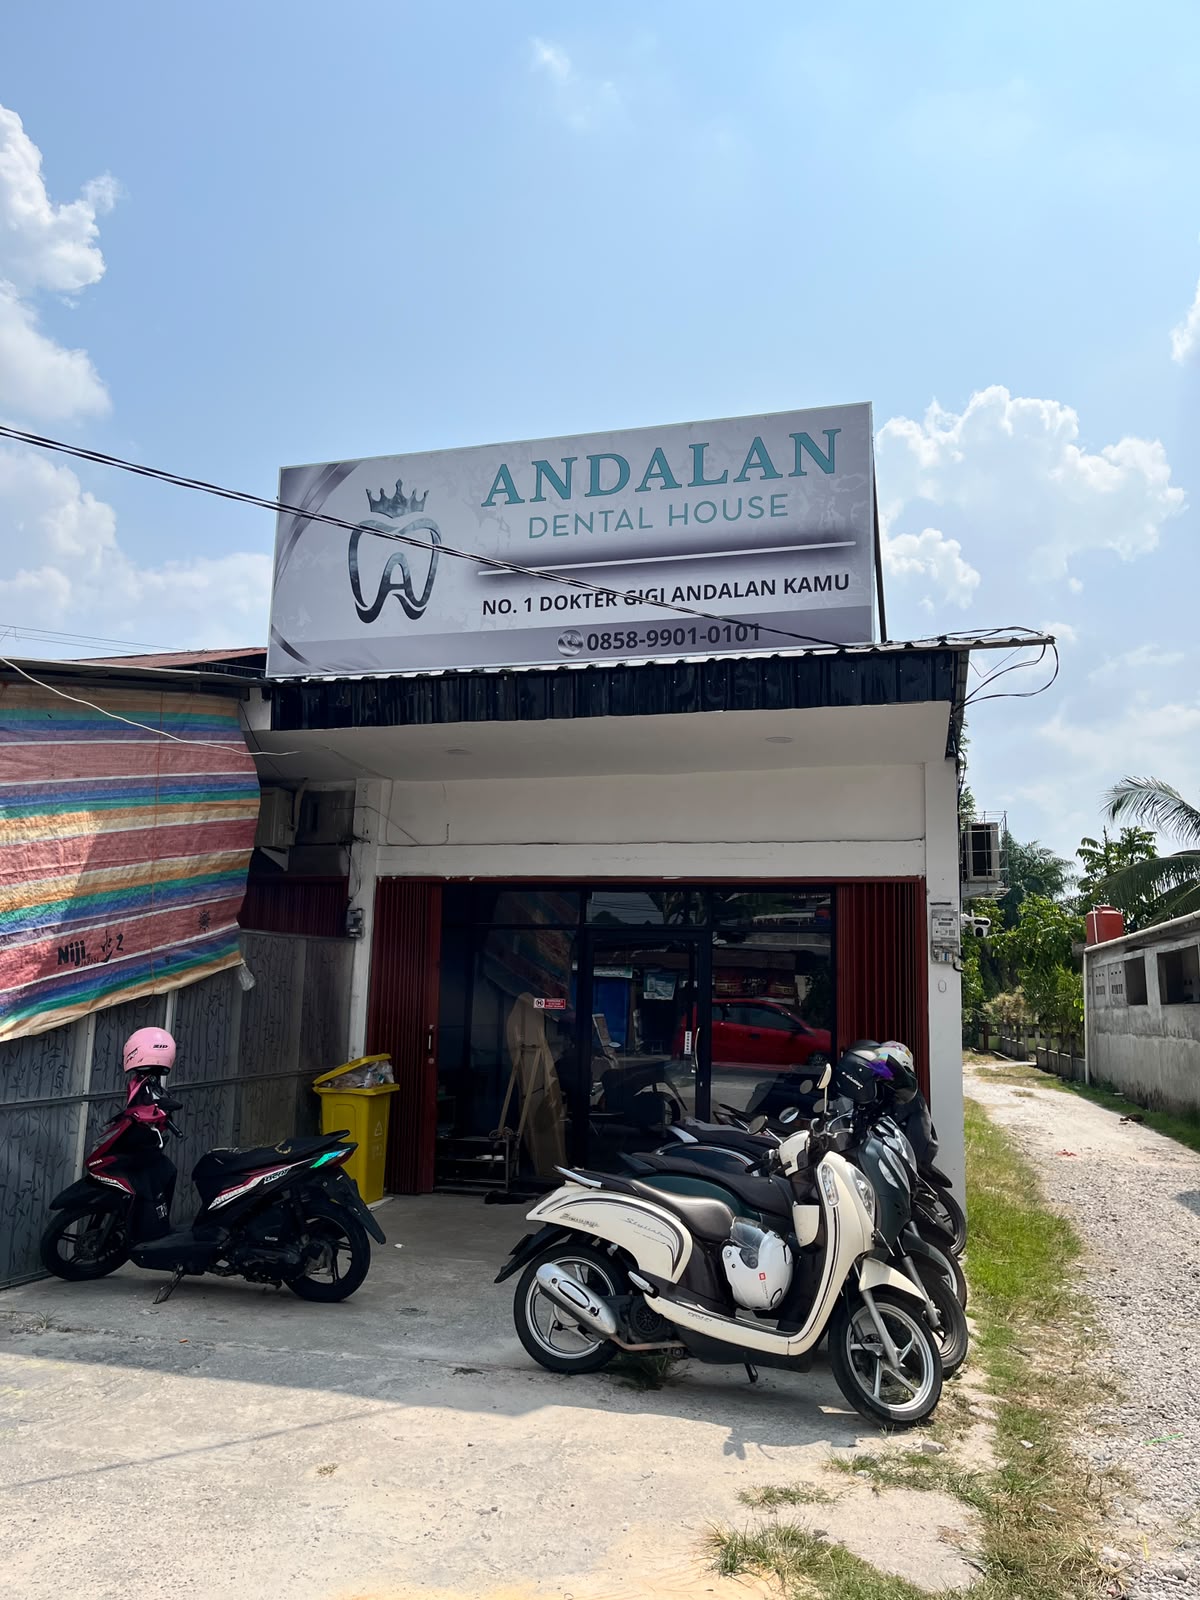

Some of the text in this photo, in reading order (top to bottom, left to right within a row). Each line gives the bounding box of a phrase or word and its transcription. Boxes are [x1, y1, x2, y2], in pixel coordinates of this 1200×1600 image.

[481, 429, 841, 507] ANDALAN
[528, 493, 788, 539] DENTAL HOUSE
[482, 573, 849, 616] NO. 1 DOKTER GIGI ANDALAN KAMU
[586, 622, 760, 651] 0858-9901-0101
[57, 940, 86, 967] Niji
